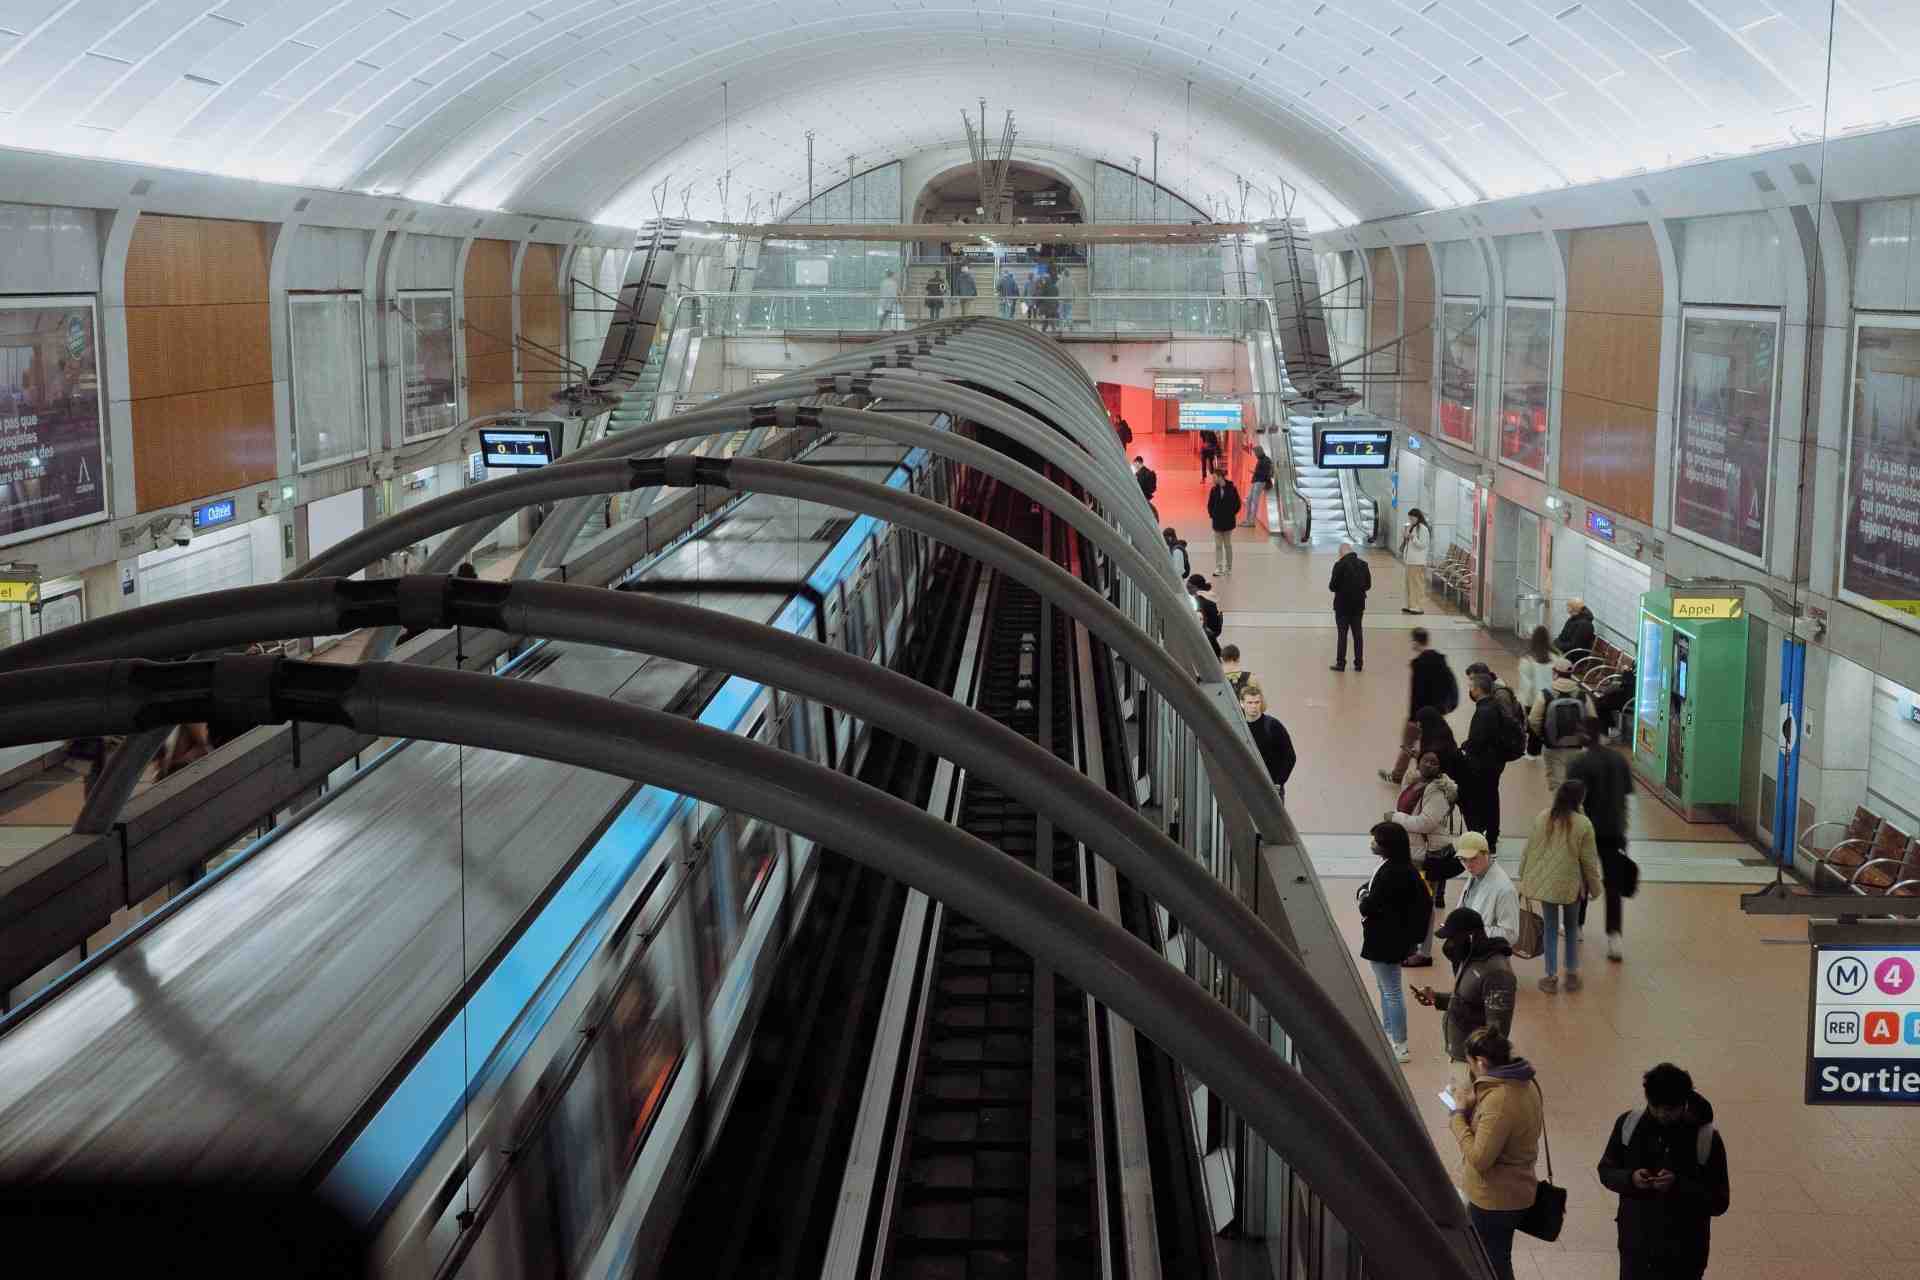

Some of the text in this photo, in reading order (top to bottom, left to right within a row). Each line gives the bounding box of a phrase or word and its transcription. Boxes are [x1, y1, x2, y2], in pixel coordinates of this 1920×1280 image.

[1680, 604, 1715, 617] Appel
[1883, 965, 1903, 988] 4
[1829, 1019, 1890, 1038] RER A
[1821, 1066, 1920, 1093] Sortie
